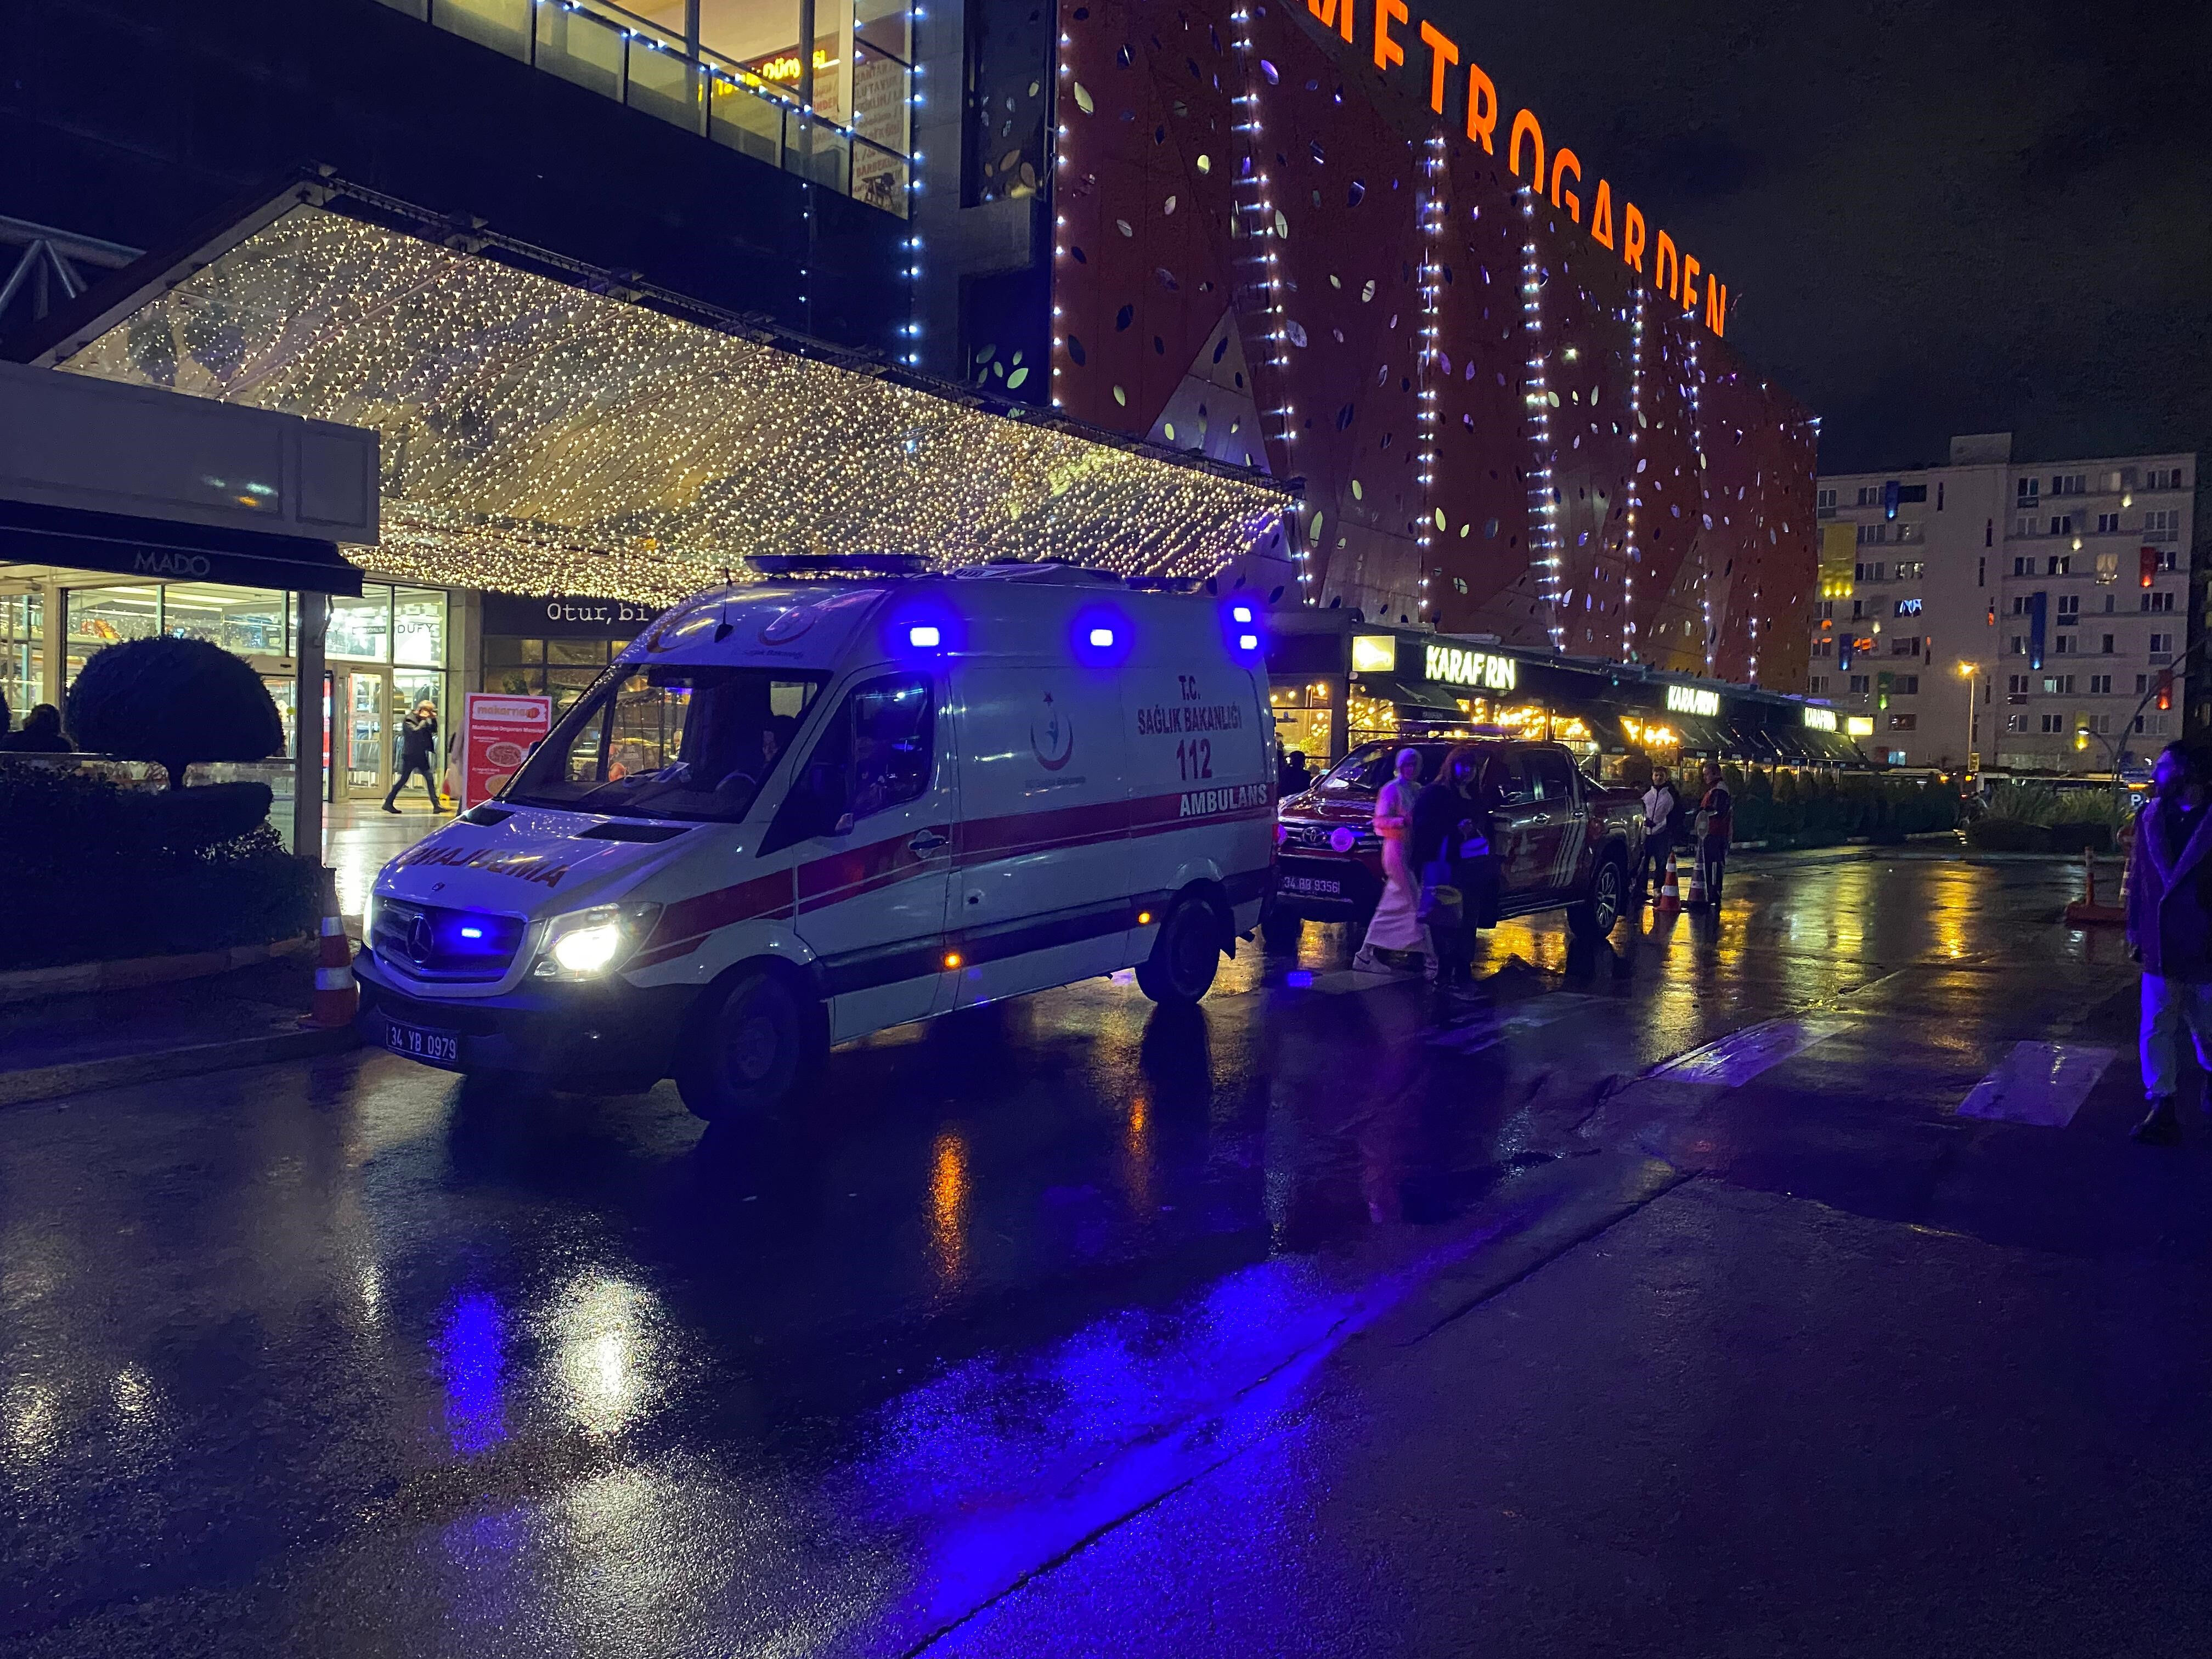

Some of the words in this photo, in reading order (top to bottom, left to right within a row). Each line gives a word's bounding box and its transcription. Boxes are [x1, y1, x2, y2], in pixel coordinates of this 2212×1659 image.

[134, 550, 210, 576] MADO
[547, 603, 612, 625] Otur,
[618, 602, 649, 621] bi
[1426, 645, 1515, 690] KARAFRIN
[1178, 675, 1201, 700] T.C.
[1138, 704, 1182, 735] SAĞLIK
[1184, 701, 1242, 732] BAKANLIĞI
[1176, 738, 1212, 781] 112
[1180, 783, 1267, 817] AMBULANS
[1284, 877, 1295, 889] 34
[391, 1026, 403, 1047] 34
[408, 1030, 421, 1052] YB
[428, 1035, 456, 1059] 0979
